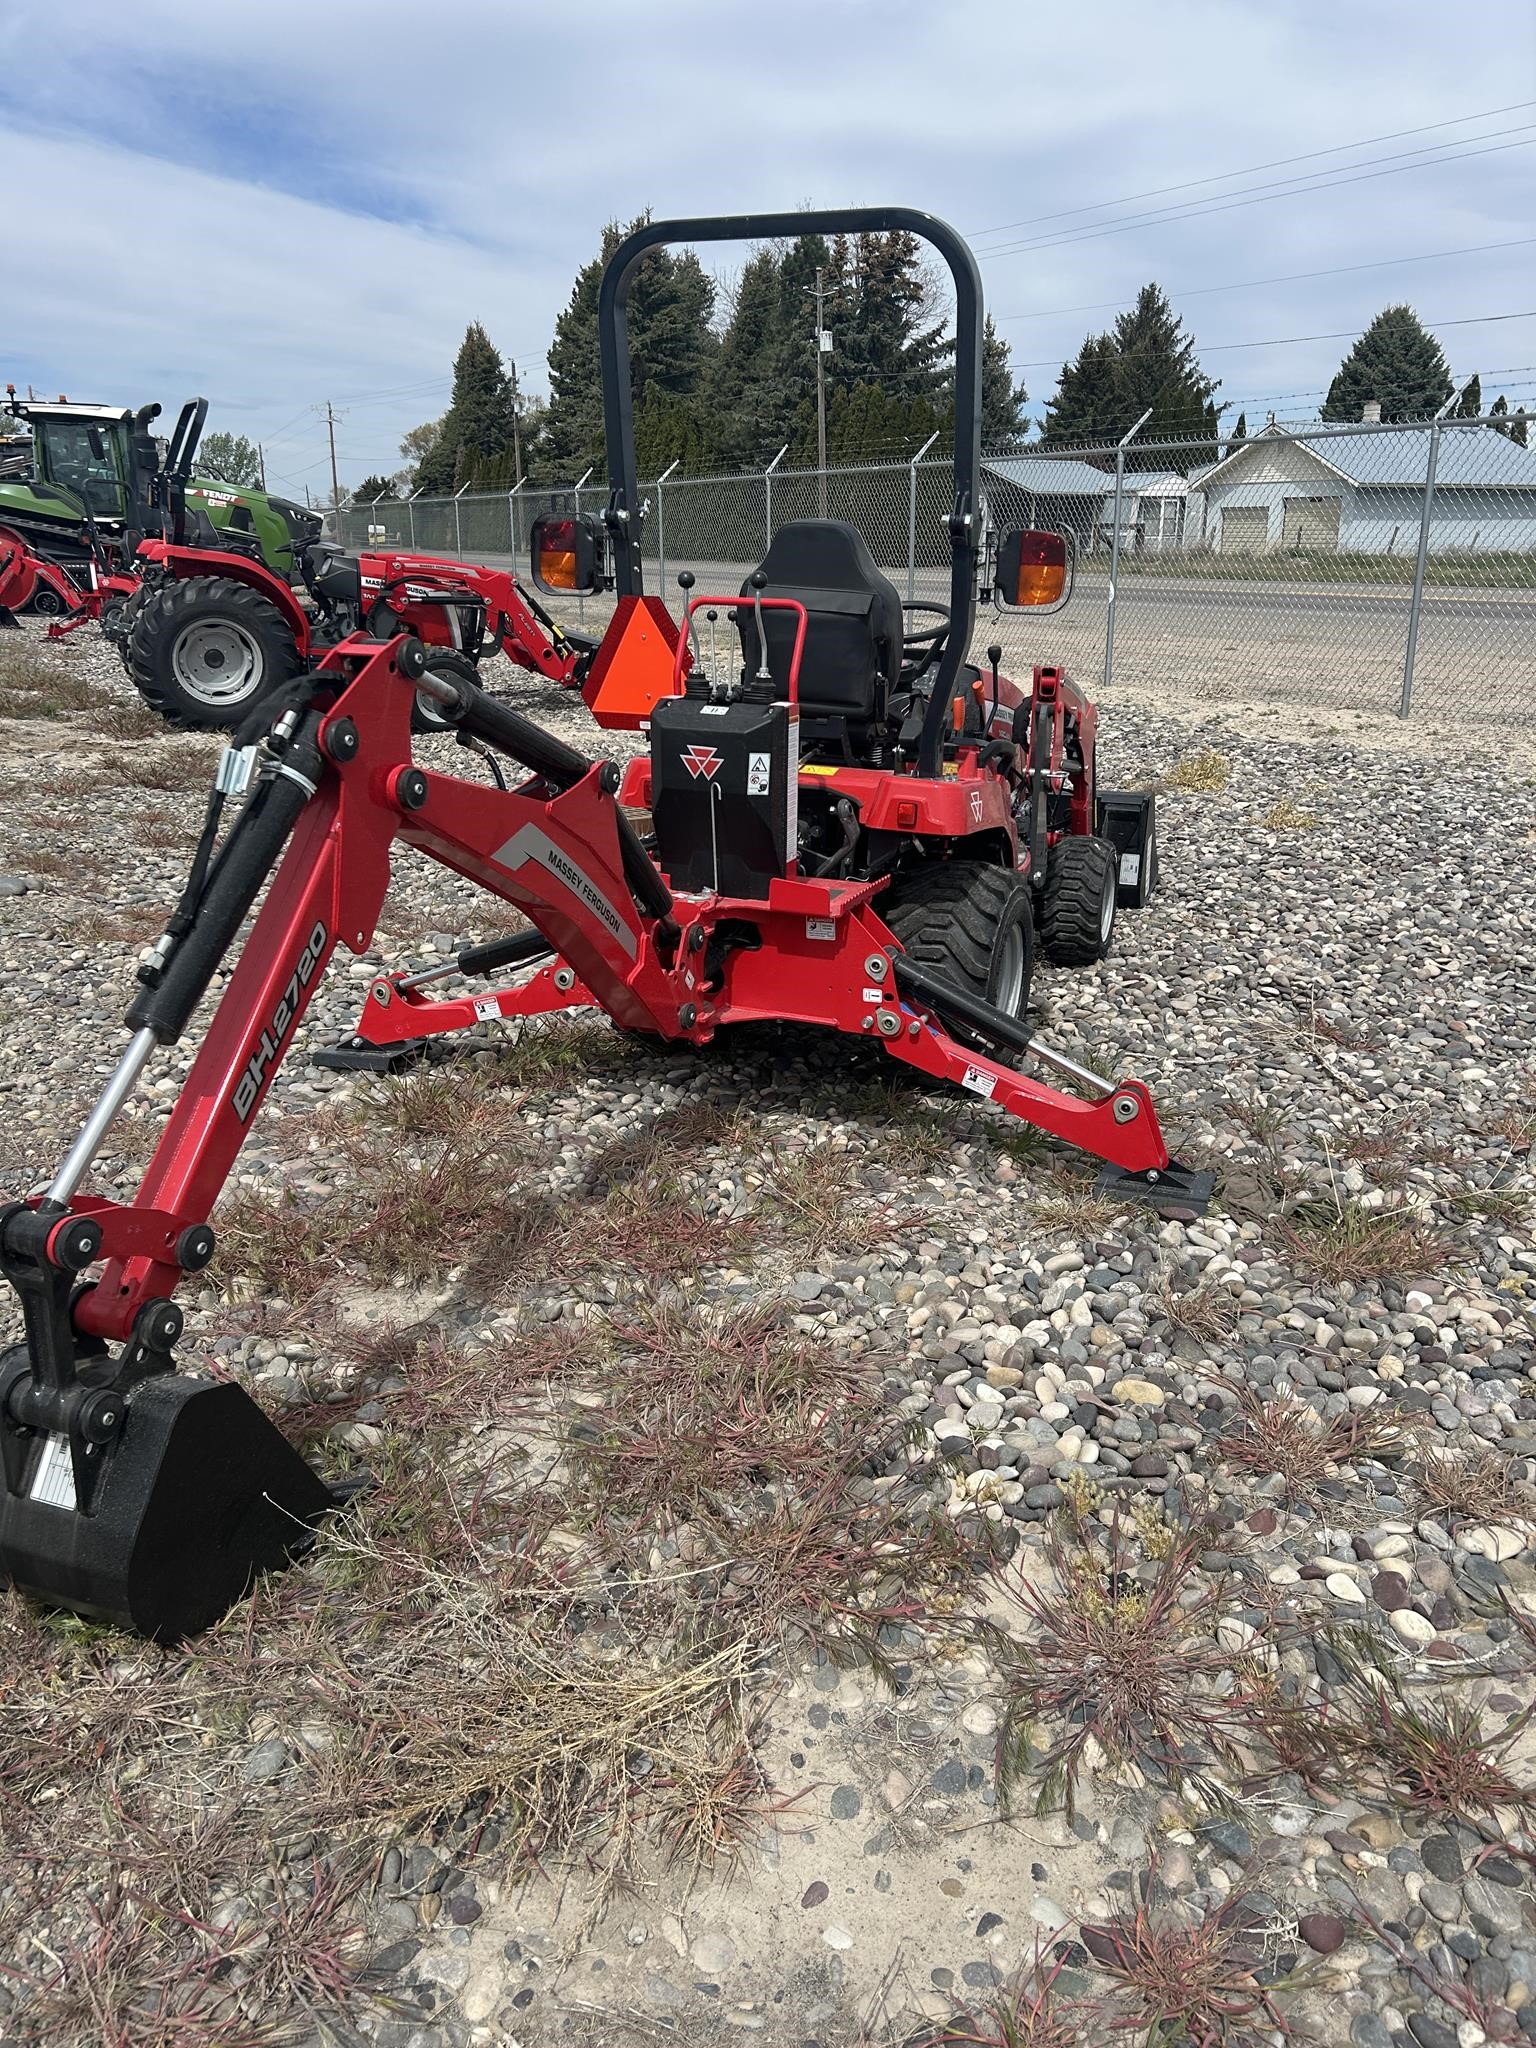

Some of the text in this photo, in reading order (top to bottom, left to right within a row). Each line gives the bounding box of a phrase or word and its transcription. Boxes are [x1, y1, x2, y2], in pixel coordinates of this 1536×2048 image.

[202, 489, 239, 502] FENDT
[547, 850, 621, 933] MASSEY FERGUSON
